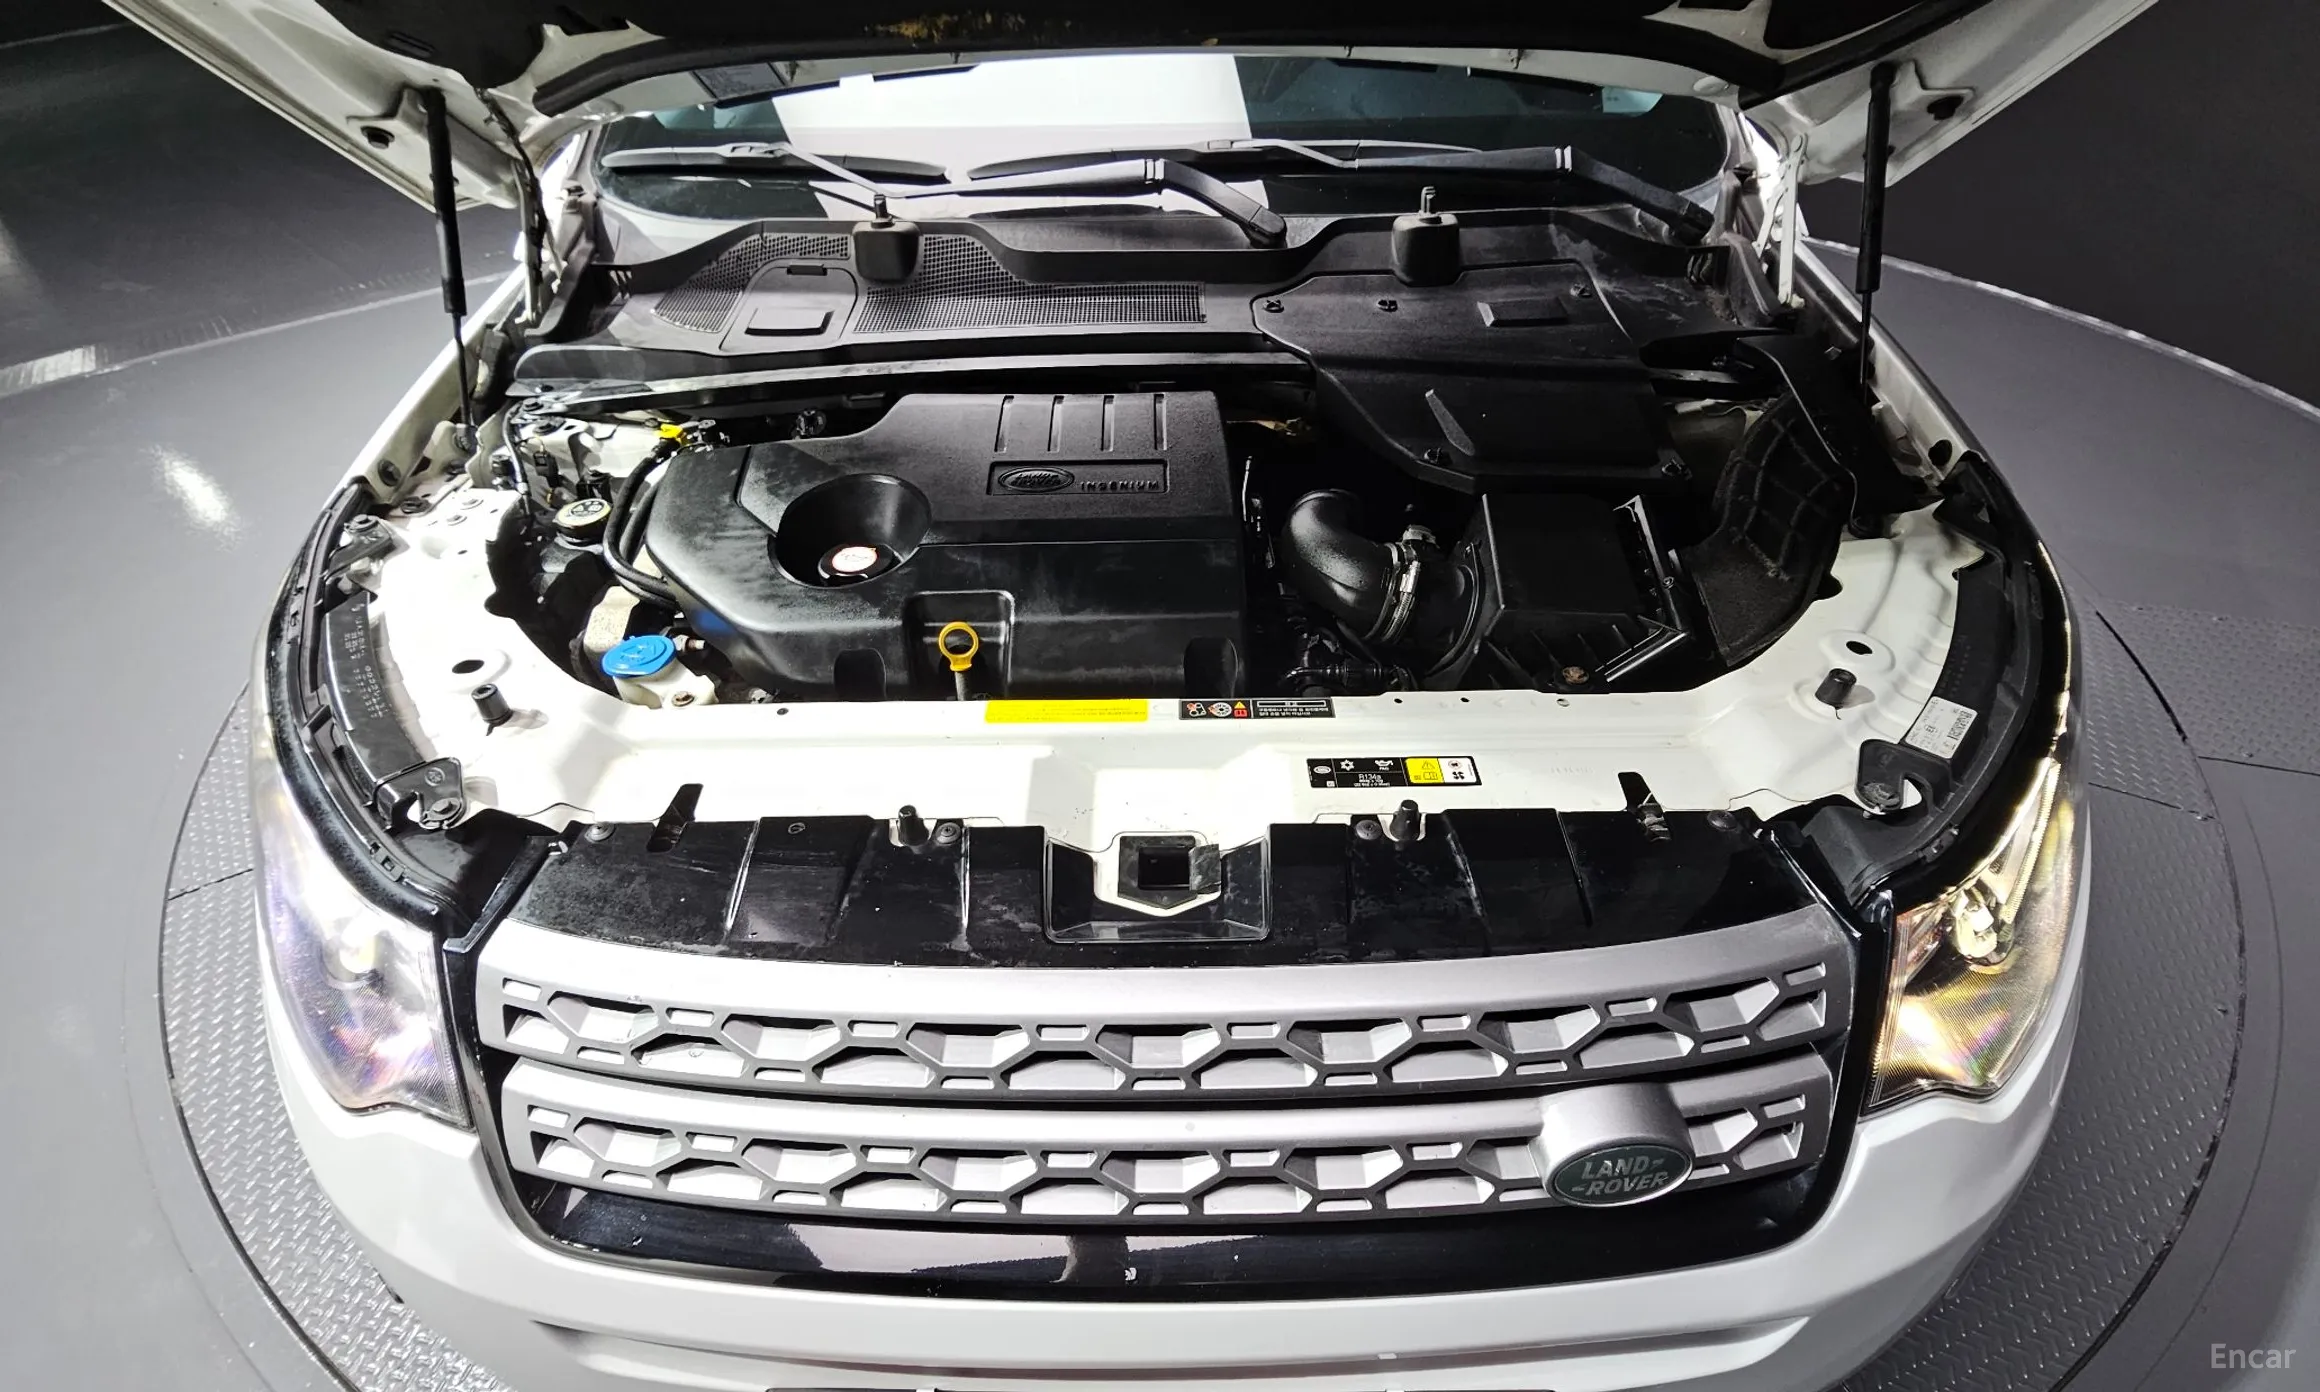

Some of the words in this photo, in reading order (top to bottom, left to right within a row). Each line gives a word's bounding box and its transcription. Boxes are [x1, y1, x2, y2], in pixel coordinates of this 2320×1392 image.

[1079, 480, 1159, 492] INGENIUM
[1581, 1155, 1650, 1180] LAND
[1584, 1171, 1669, 1196] ROVER
